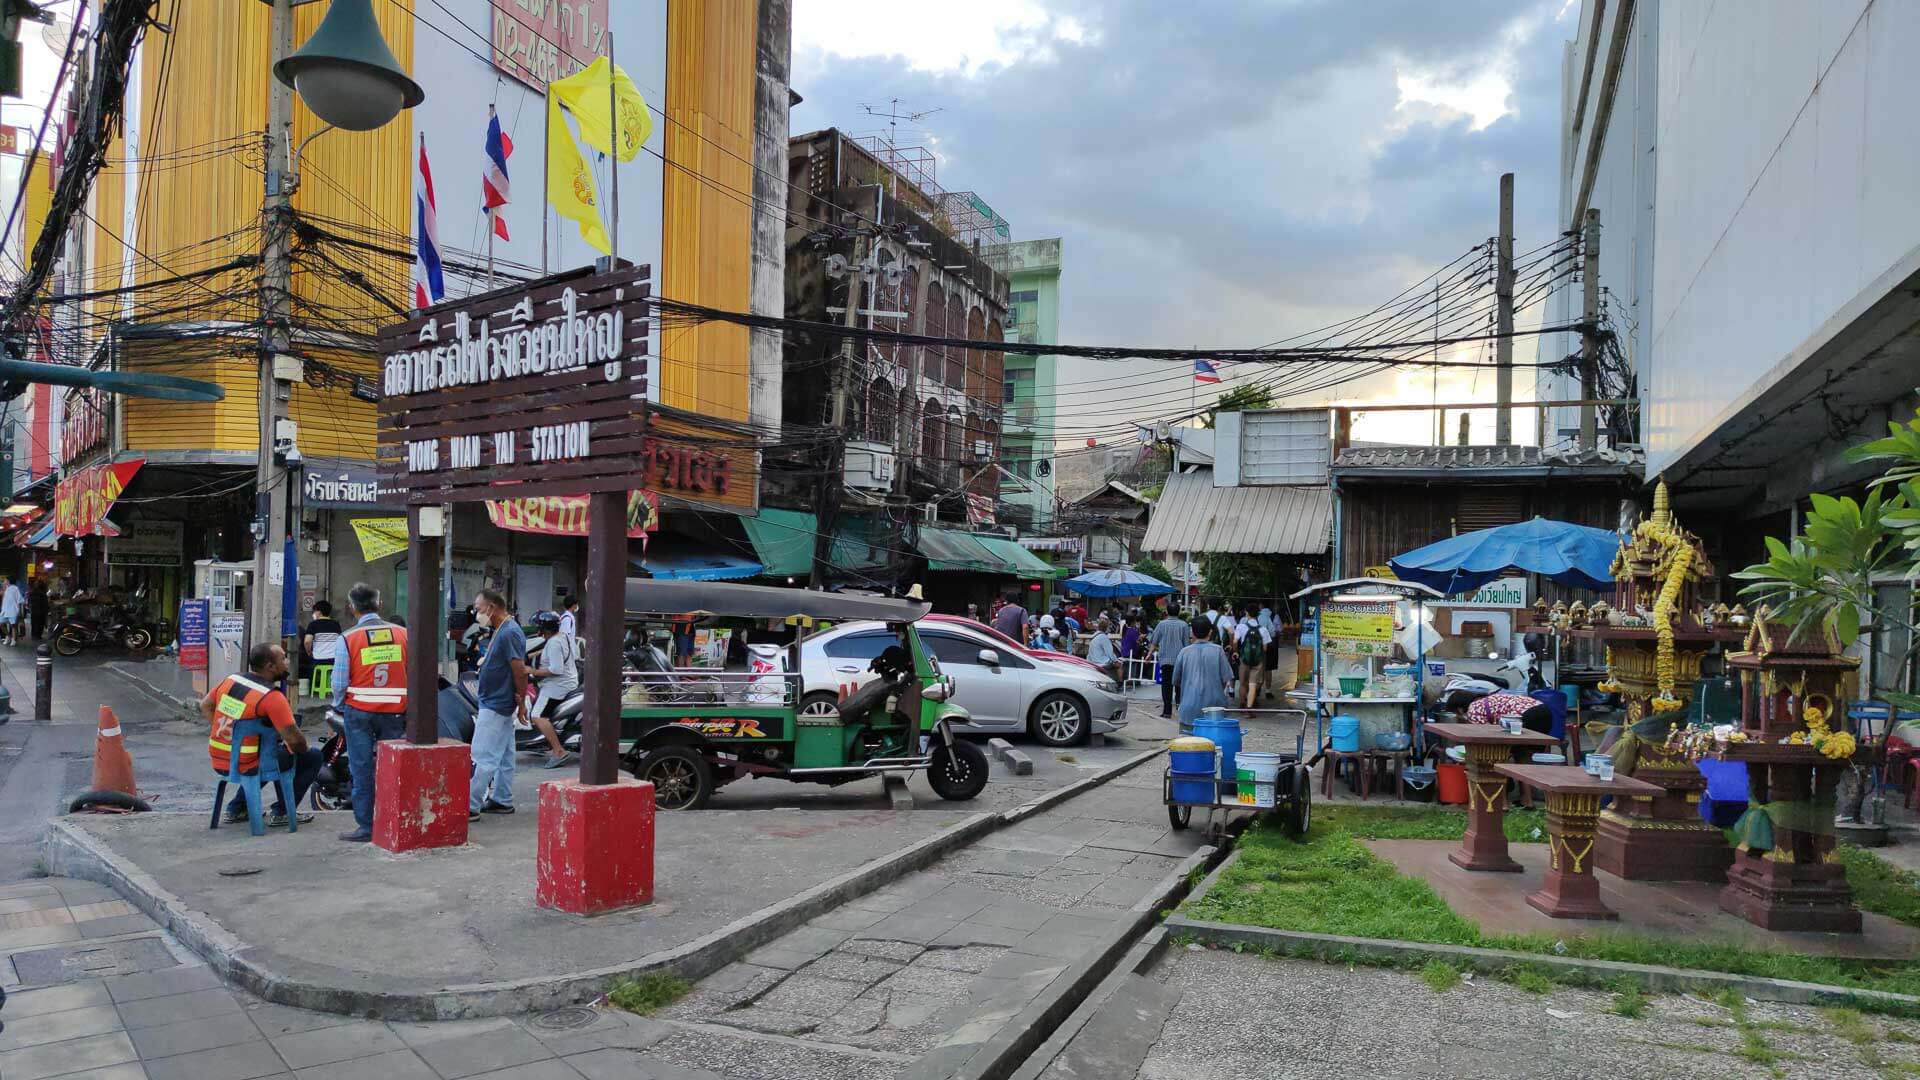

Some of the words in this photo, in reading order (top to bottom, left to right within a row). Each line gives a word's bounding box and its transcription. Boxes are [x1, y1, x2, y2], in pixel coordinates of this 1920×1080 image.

[384, 287, 624, 396] สถานีรถไฟวงเวียนใหญ่
[408, 439, 439, 472] WONG
[450, 435, 481, 468] WIAN
[494, 430, 515, 464] YAI
[531, 421, 591, 460] STATION
[373, 664, 390, 688] 5
